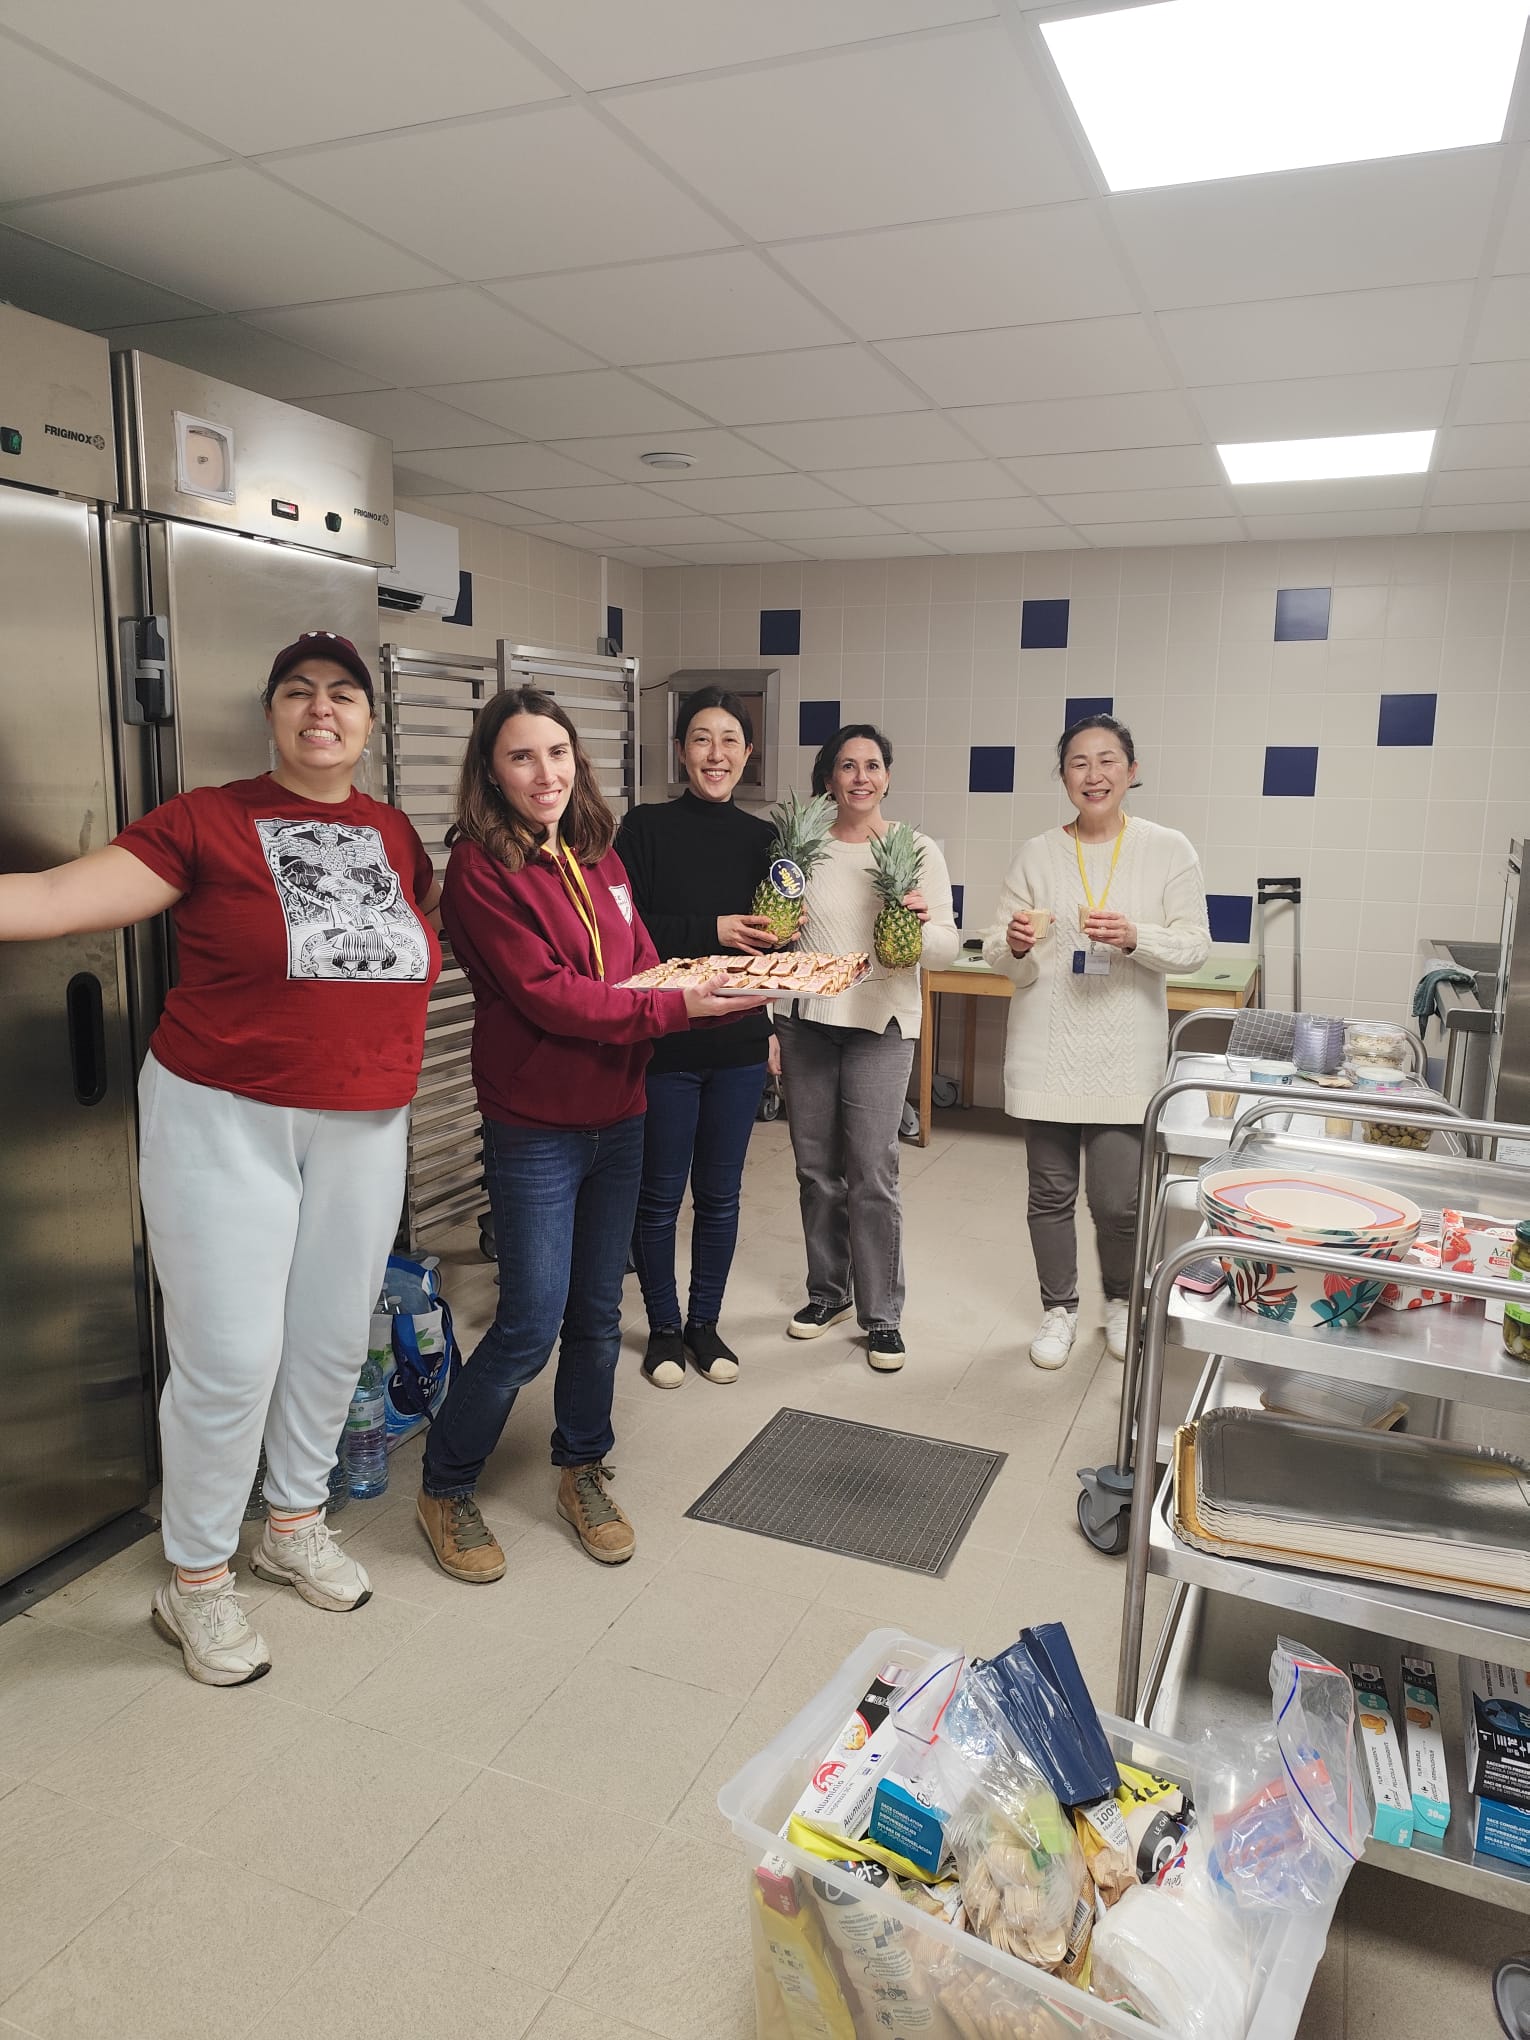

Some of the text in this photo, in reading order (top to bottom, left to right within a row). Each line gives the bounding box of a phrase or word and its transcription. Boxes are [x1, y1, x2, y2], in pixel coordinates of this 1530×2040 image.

[44, 424, 92, 444] FRIGINOX
[353, 508, 381, 521] FRIGINOX
[843, 1786, 873, 1829] Aluminium
